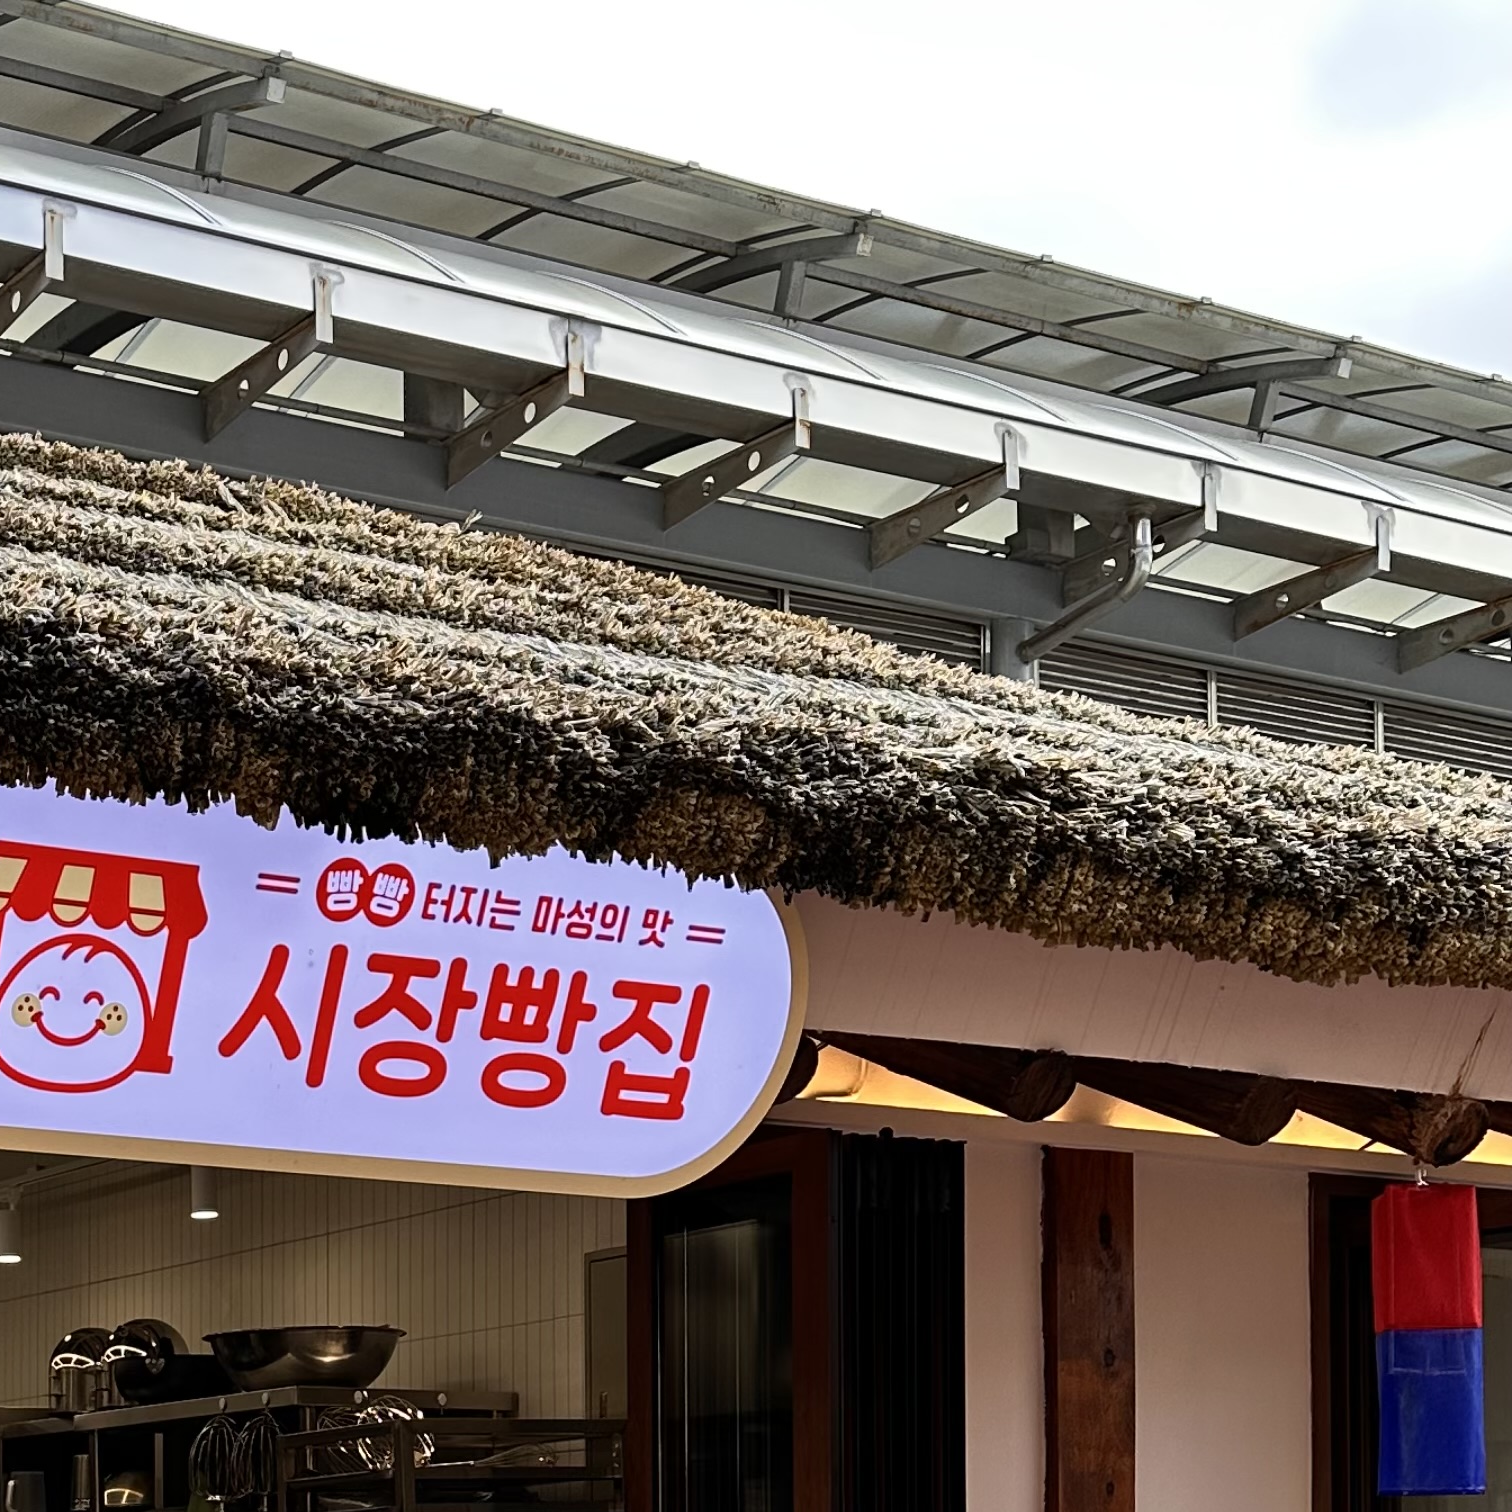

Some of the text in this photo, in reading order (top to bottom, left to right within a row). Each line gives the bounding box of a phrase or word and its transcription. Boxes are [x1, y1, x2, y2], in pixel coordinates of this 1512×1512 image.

[325, 866, 674, 949] 빵빵 터지는 마성의 맛
[217, 943, 711, 1121] 시장빵집
